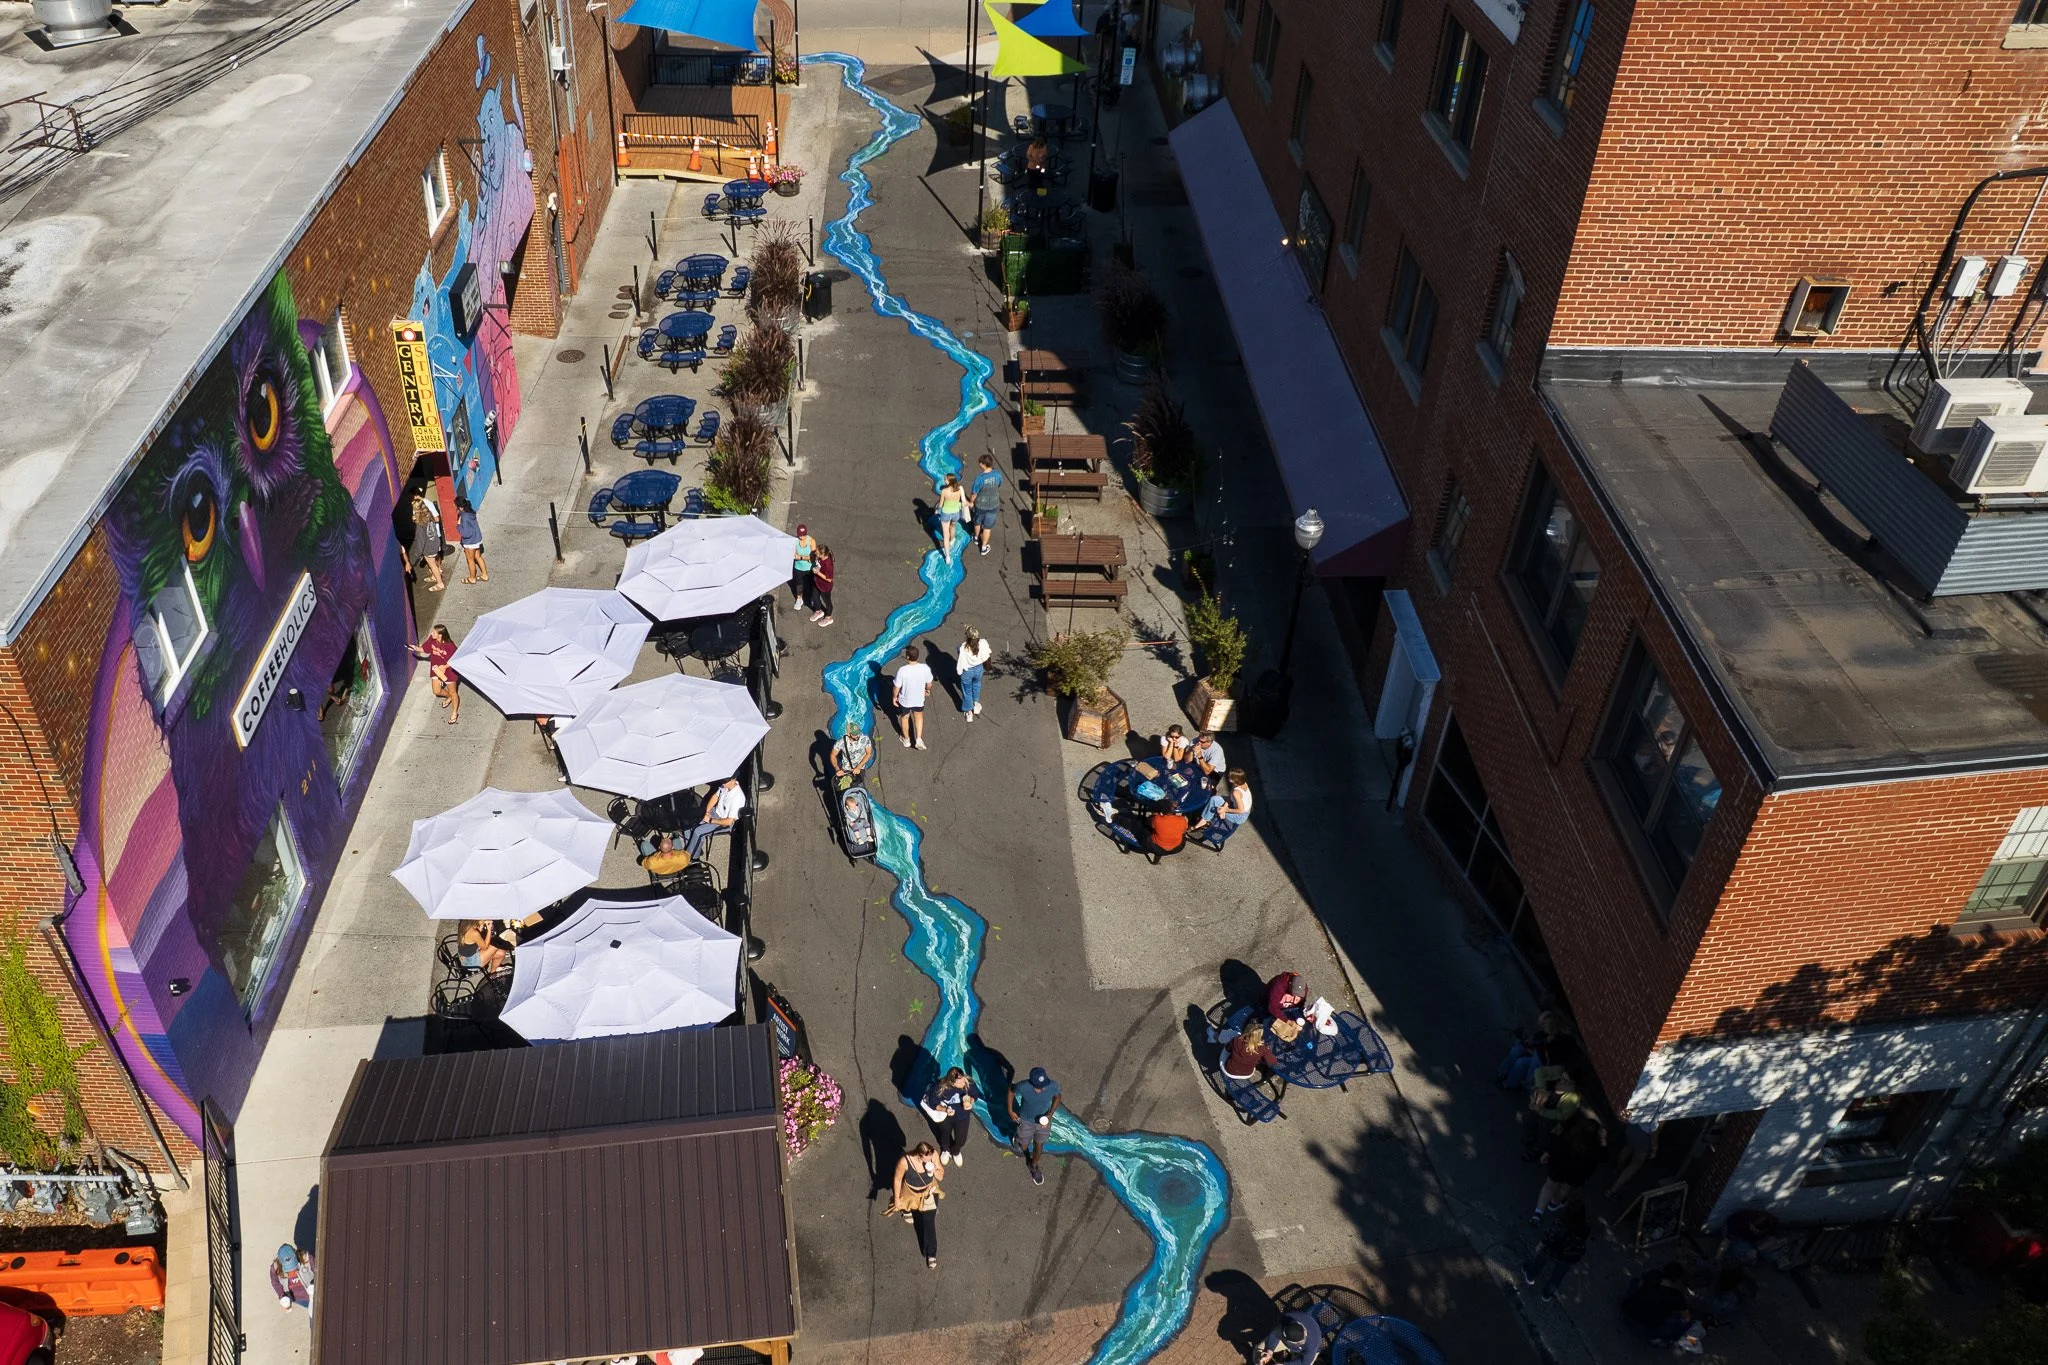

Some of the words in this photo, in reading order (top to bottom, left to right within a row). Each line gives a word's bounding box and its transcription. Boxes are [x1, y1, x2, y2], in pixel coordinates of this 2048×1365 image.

[398, 346, 423, 426] GENTRY
[414, 346, 438, 426] STUDIO
[414, 427, 440, 435] JOHN'S
[242, 583, 315, 733] COFFEEHOLICS
